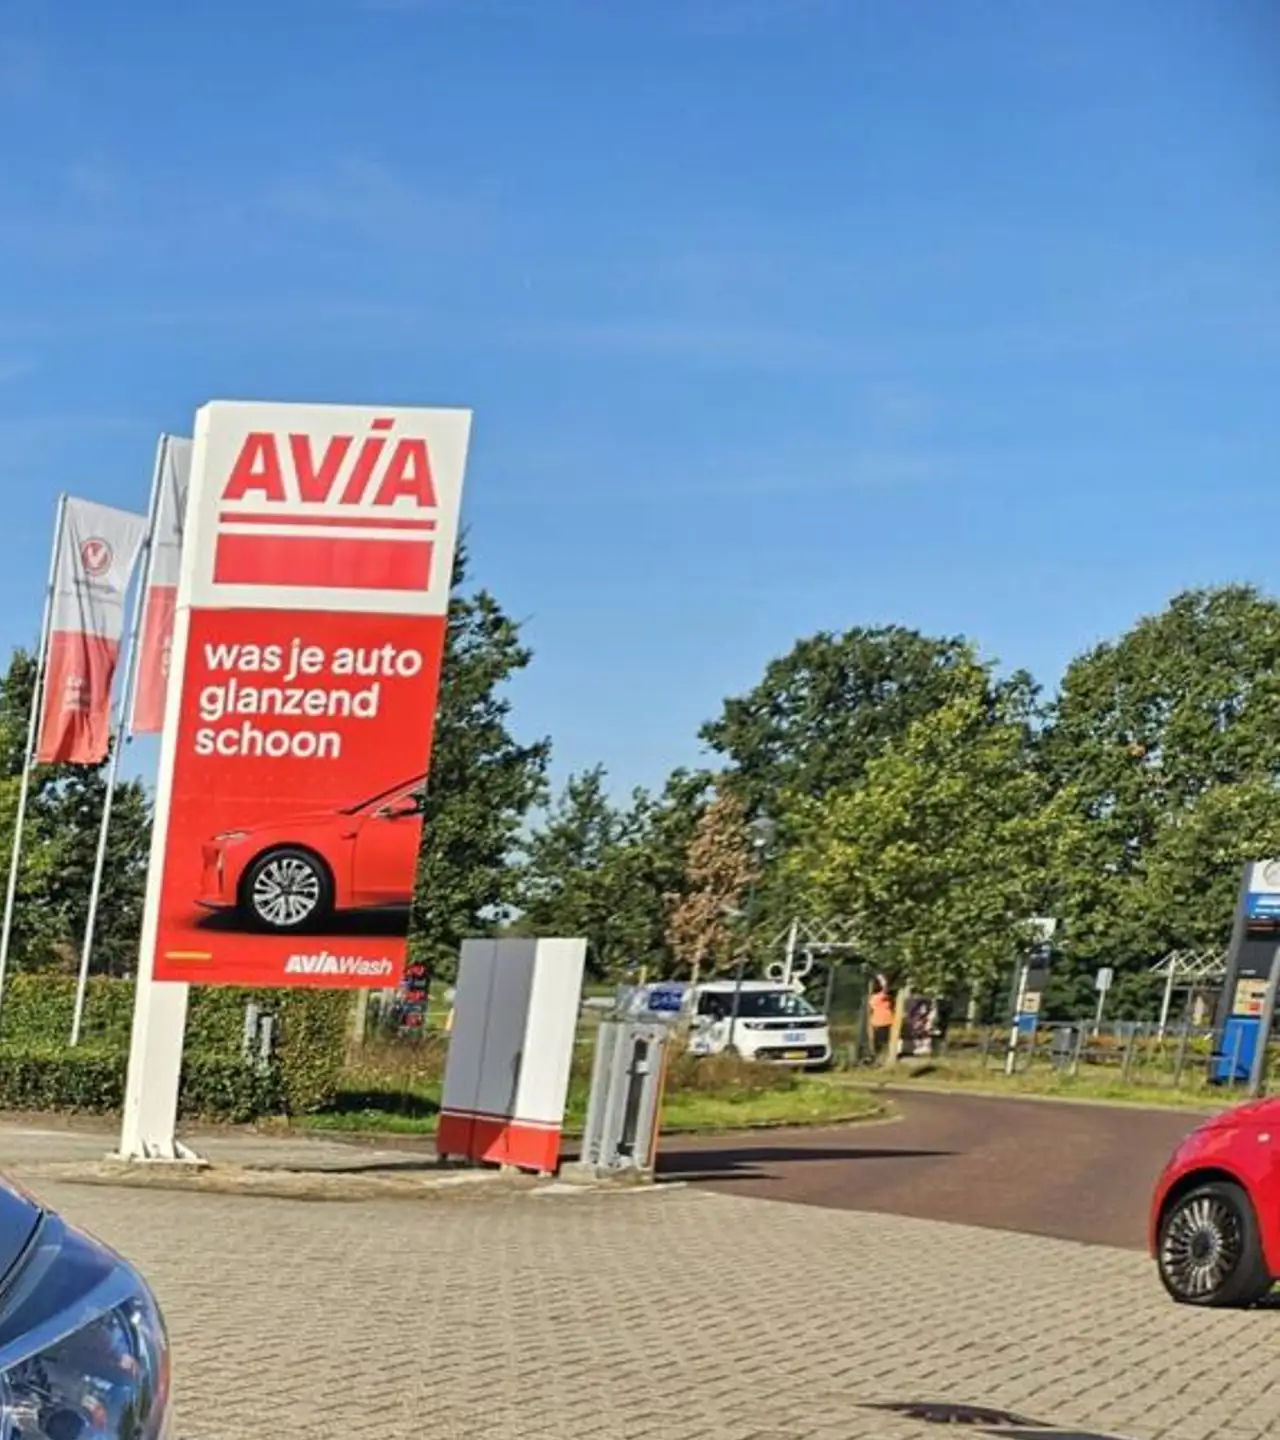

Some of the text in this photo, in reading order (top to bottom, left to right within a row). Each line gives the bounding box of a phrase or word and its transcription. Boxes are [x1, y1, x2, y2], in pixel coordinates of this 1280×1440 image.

[204, 643, 283, 672] was
[283, 637, 325, 682] je
[331, 643, 422, 677] auto
[199, 677, 381, 721] glanzend
[195, 720, 341, 758] schoon
